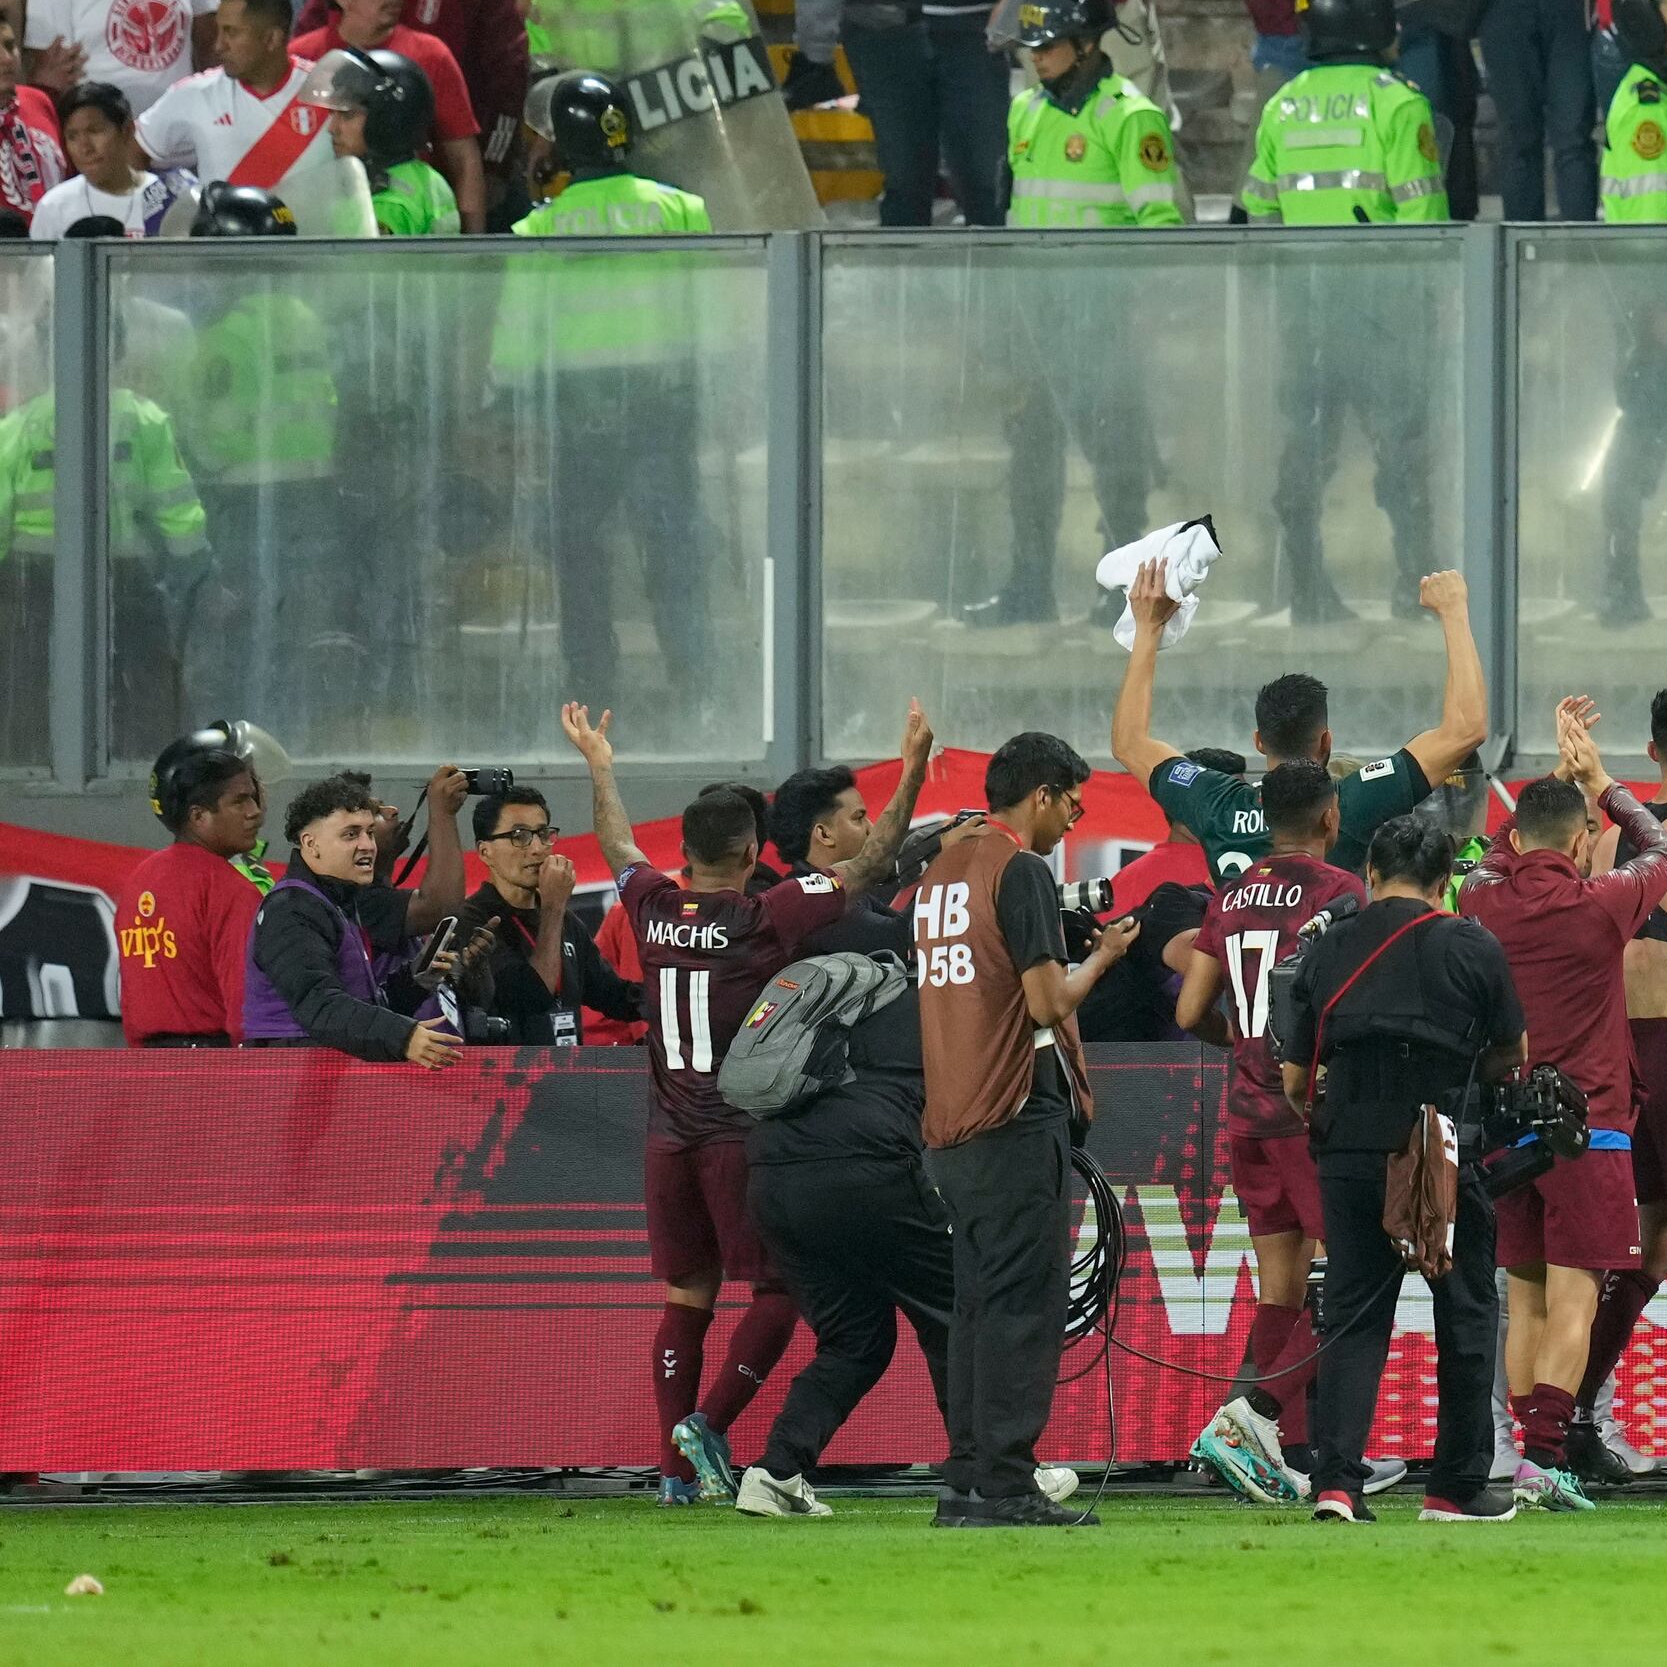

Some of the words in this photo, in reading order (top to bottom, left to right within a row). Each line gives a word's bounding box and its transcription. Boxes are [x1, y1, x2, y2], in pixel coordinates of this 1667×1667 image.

[627, 43, 771, 132] LICIA
[1279, 98, 1368, 125] POLICIA
[1222, 884, 1303, 914] CASTILLO
[646, 920, 730, 951] MACHÍS
[1224, 928, 1280, 1040] 17
[659, 966, 713, 1074] 11
[664, 1349, 677, 1380] FVF
